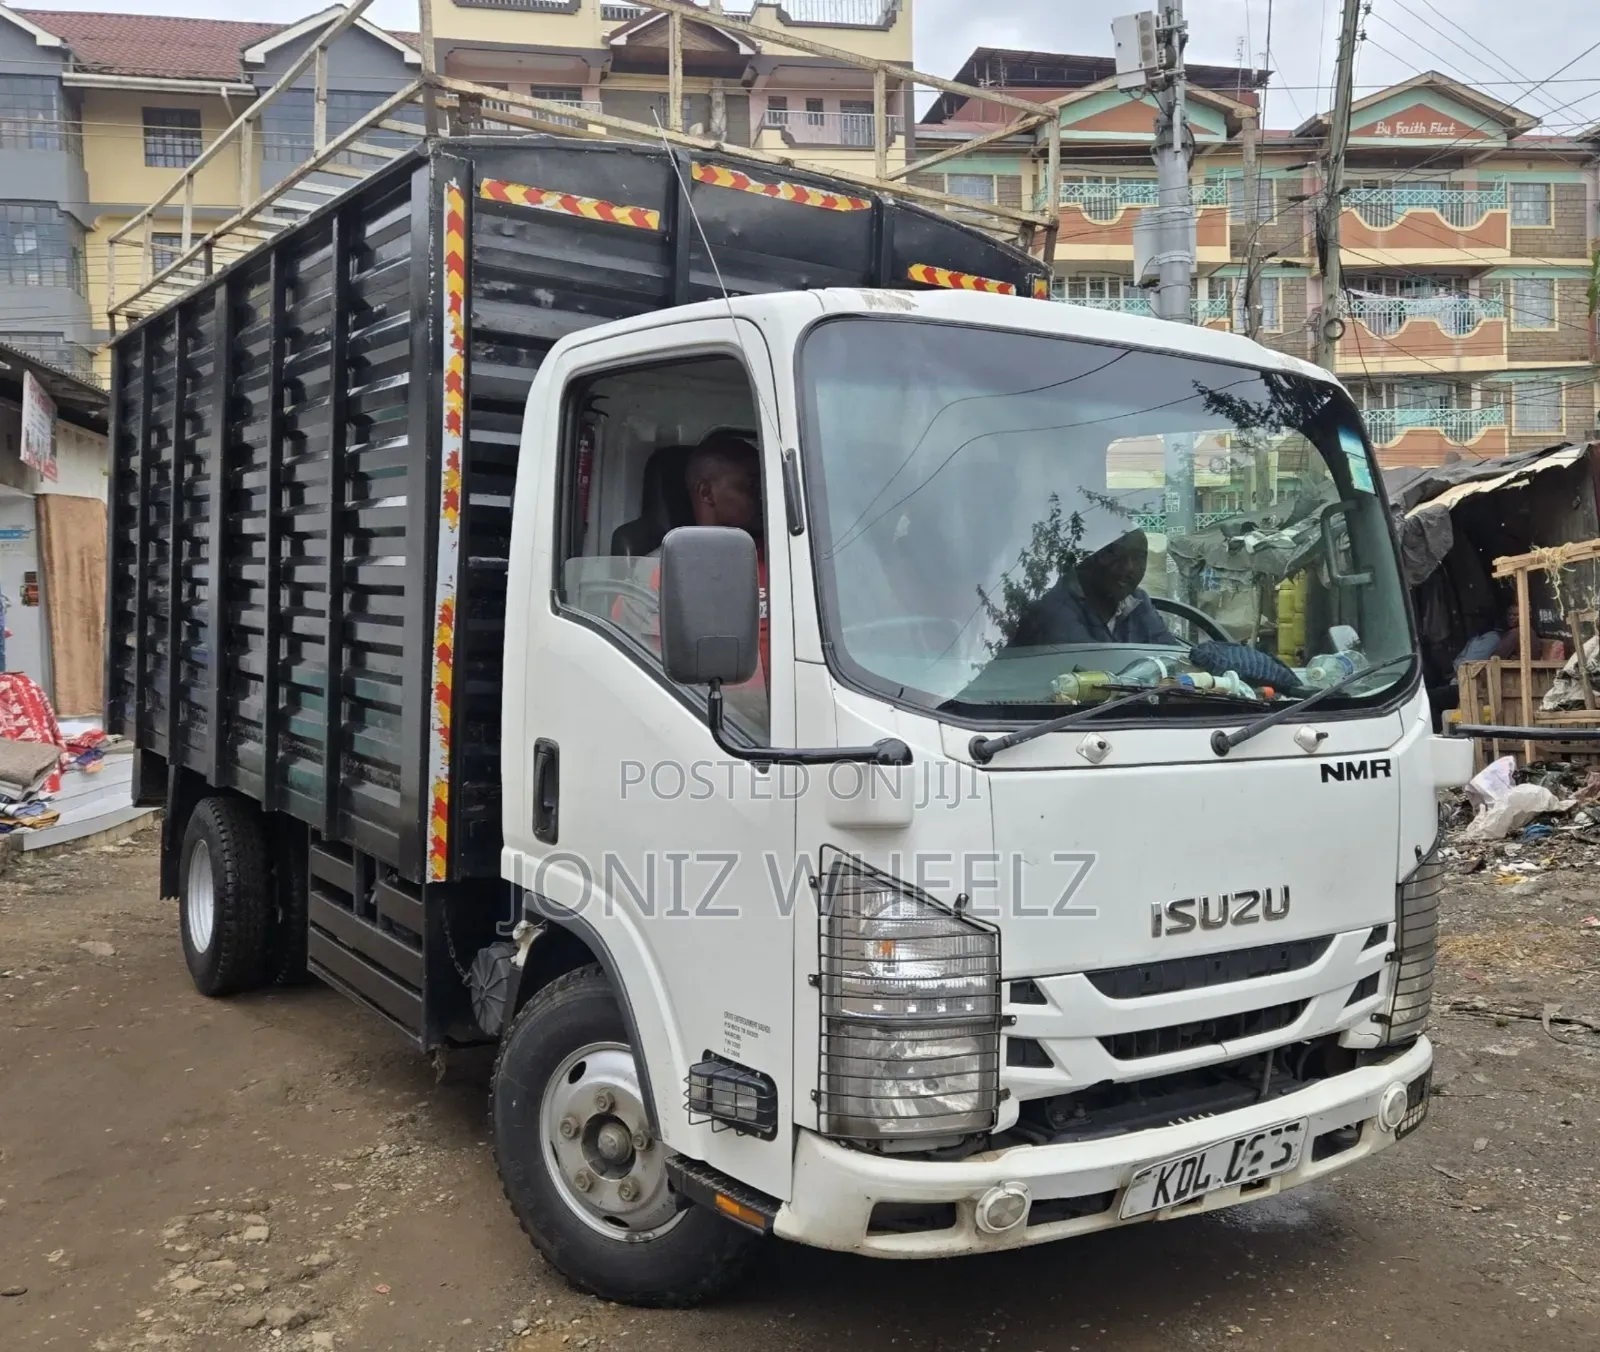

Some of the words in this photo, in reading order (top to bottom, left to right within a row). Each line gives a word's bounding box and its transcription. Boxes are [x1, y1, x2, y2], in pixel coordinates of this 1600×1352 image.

[1374, 121, 1391, 138] By
[1395, 121, 1427, 136] Faith
[1320, 758, 1392, 783] NMR
[1150, 885, 1290, 938] ISUZU
[1151, 1152, 1211, 1208] KDL
